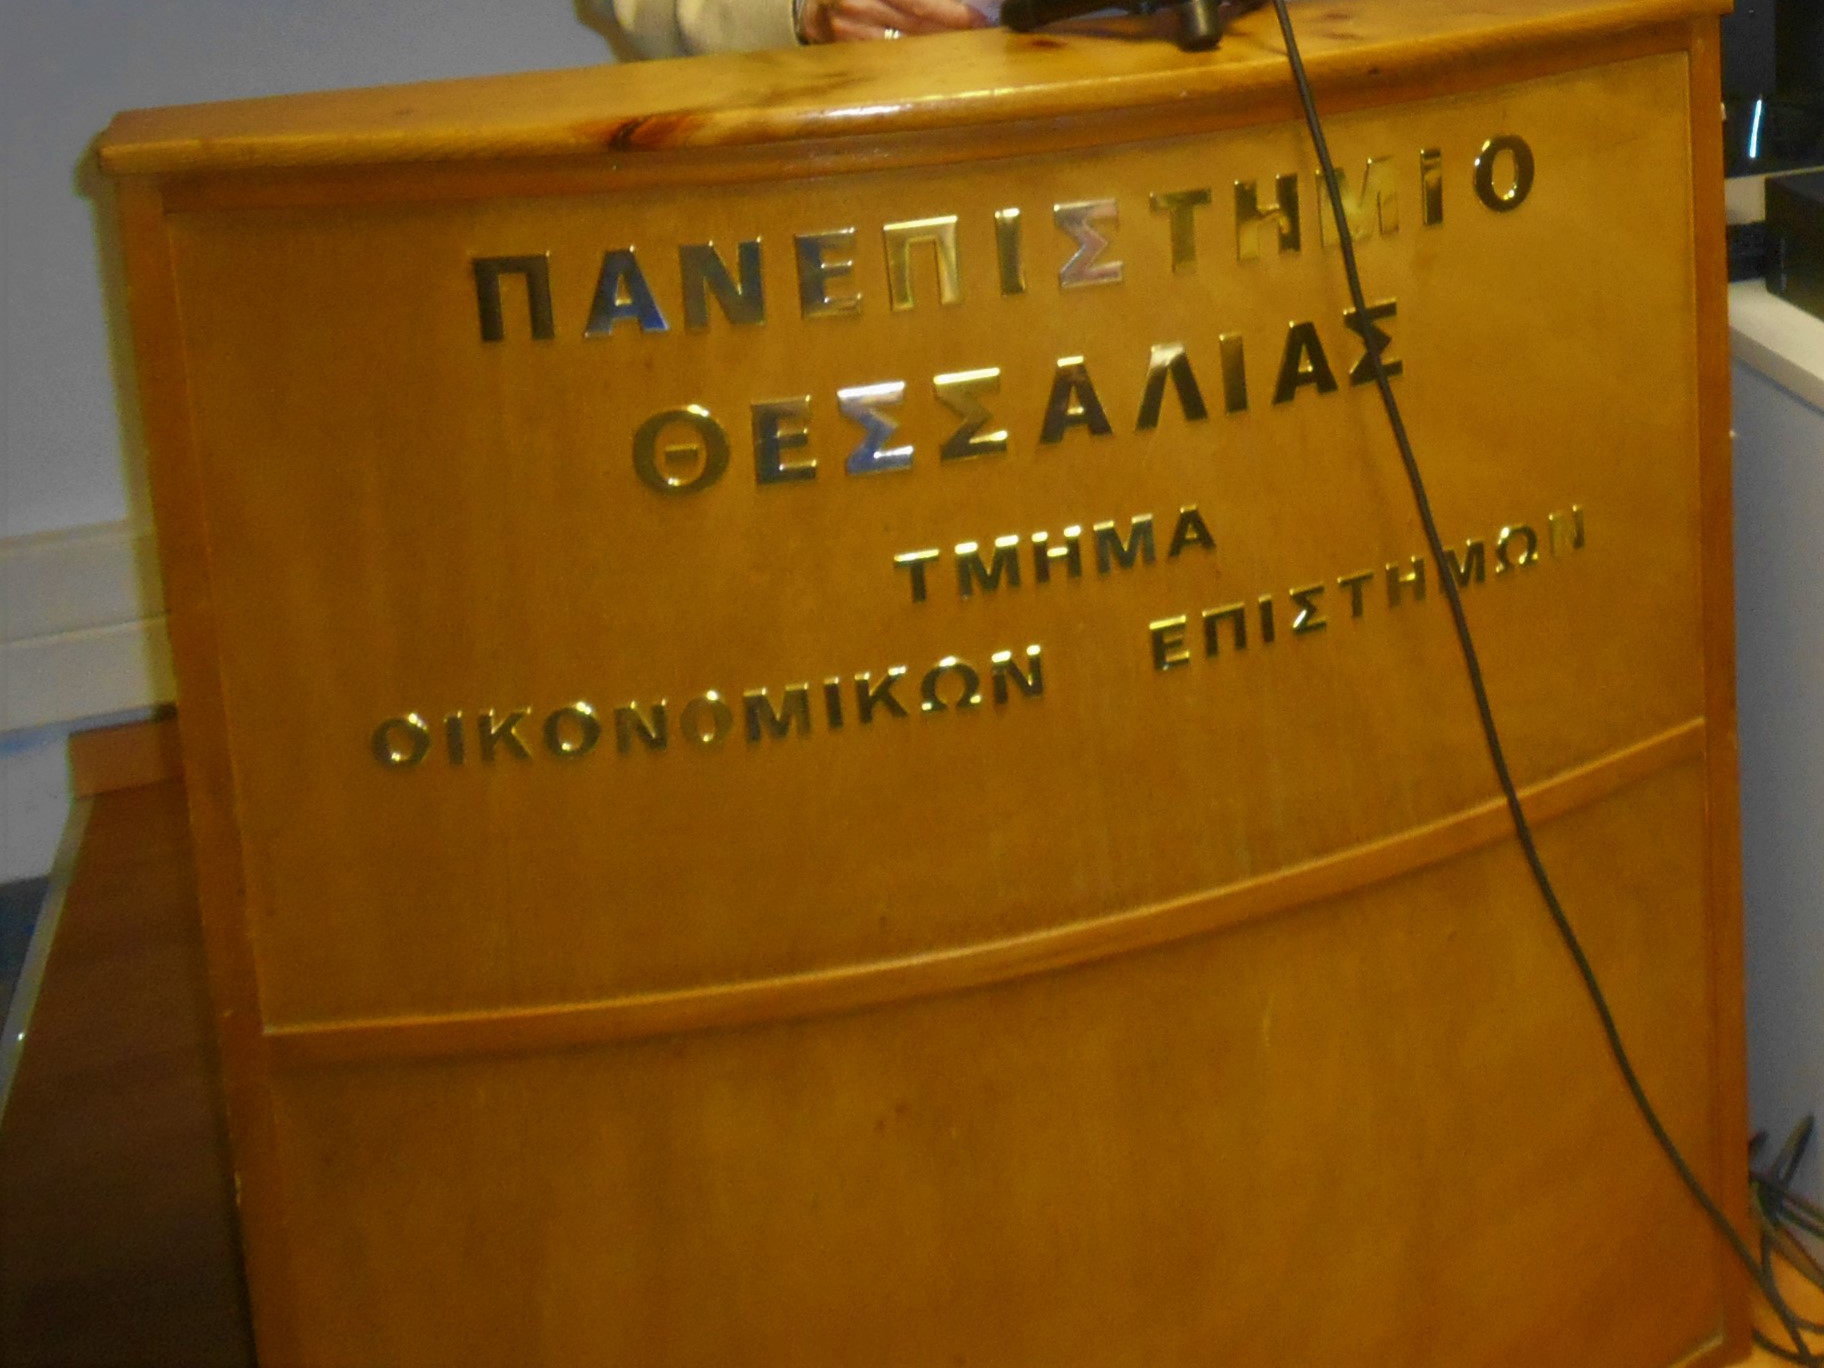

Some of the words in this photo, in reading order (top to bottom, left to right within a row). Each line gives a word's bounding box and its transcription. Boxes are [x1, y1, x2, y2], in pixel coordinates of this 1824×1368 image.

[472, 134, 1535, 342] ΠΑΝΕΠΙΣΤΗΜΙΟ
[632, 297, 1403, 495] ΘΕΣΣΑΛΙΑΣ
[371, 644, 1046, 771] ΟΙΚΟΝΟΜΙΚΩΝ
[1149, 504, 1586, 671] ΕΠΙΣΤΗΜΩΝ
[893, 504, 1216, 604] ΤΜΗΜΑ
